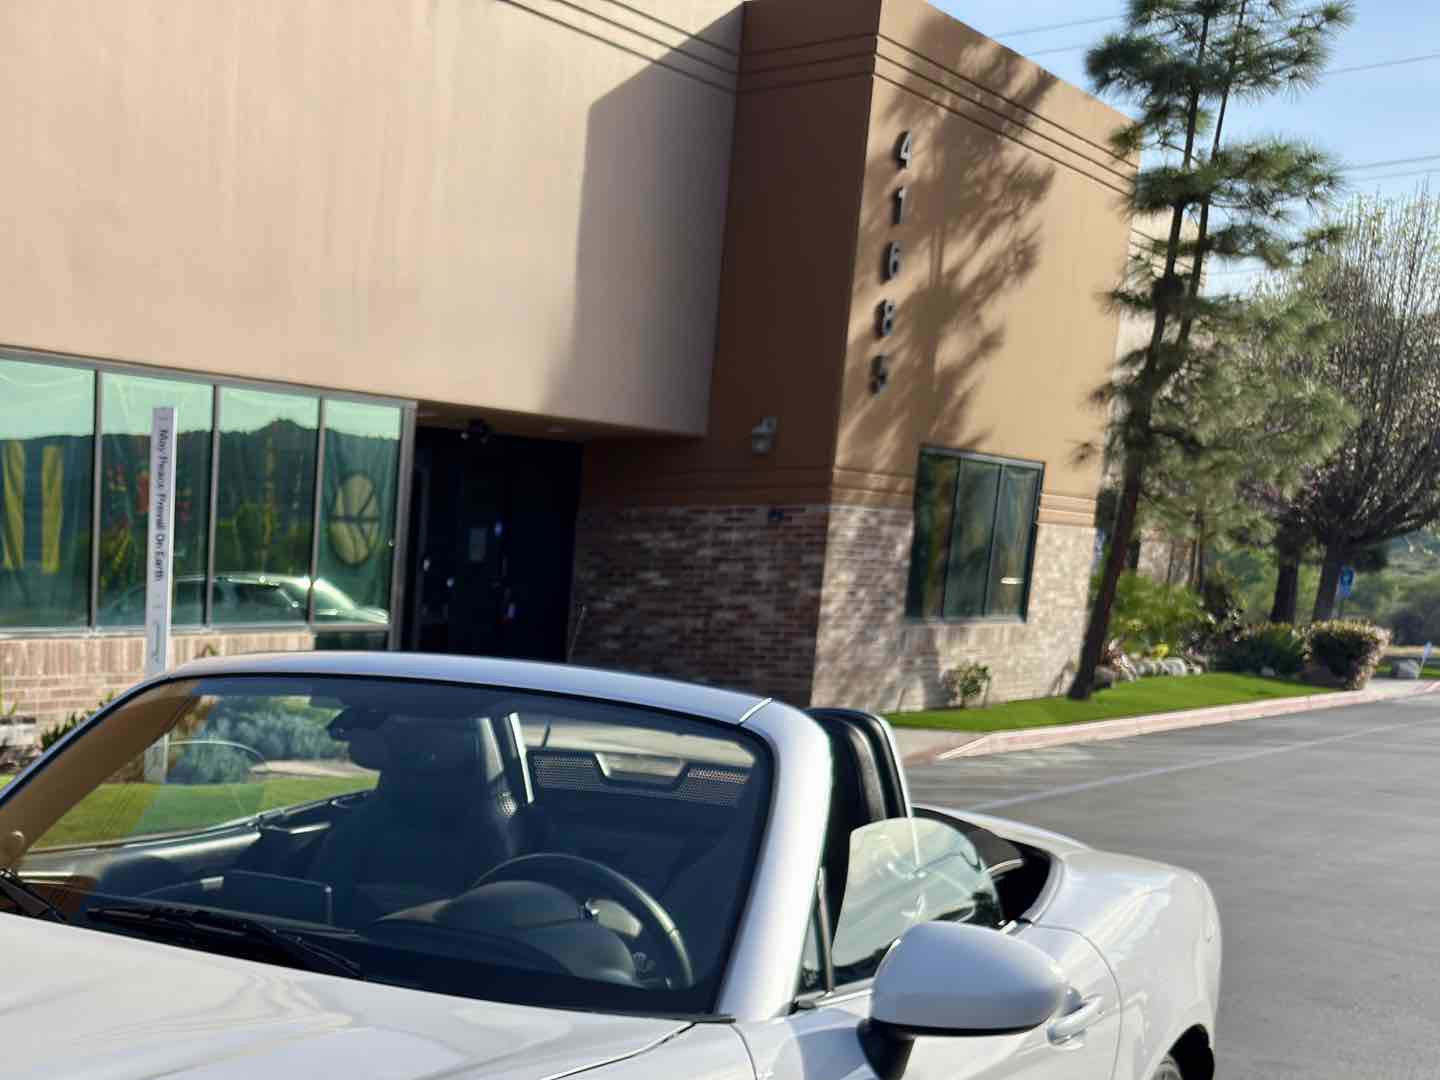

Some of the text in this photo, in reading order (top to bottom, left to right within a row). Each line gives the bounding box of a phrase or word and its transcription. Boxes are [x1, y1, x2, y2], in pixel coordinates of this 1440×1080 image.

[158, 428, 169, 454] May
[155, 493, 167, 531] Prevail
[153, 551, 165, 582] Earth
